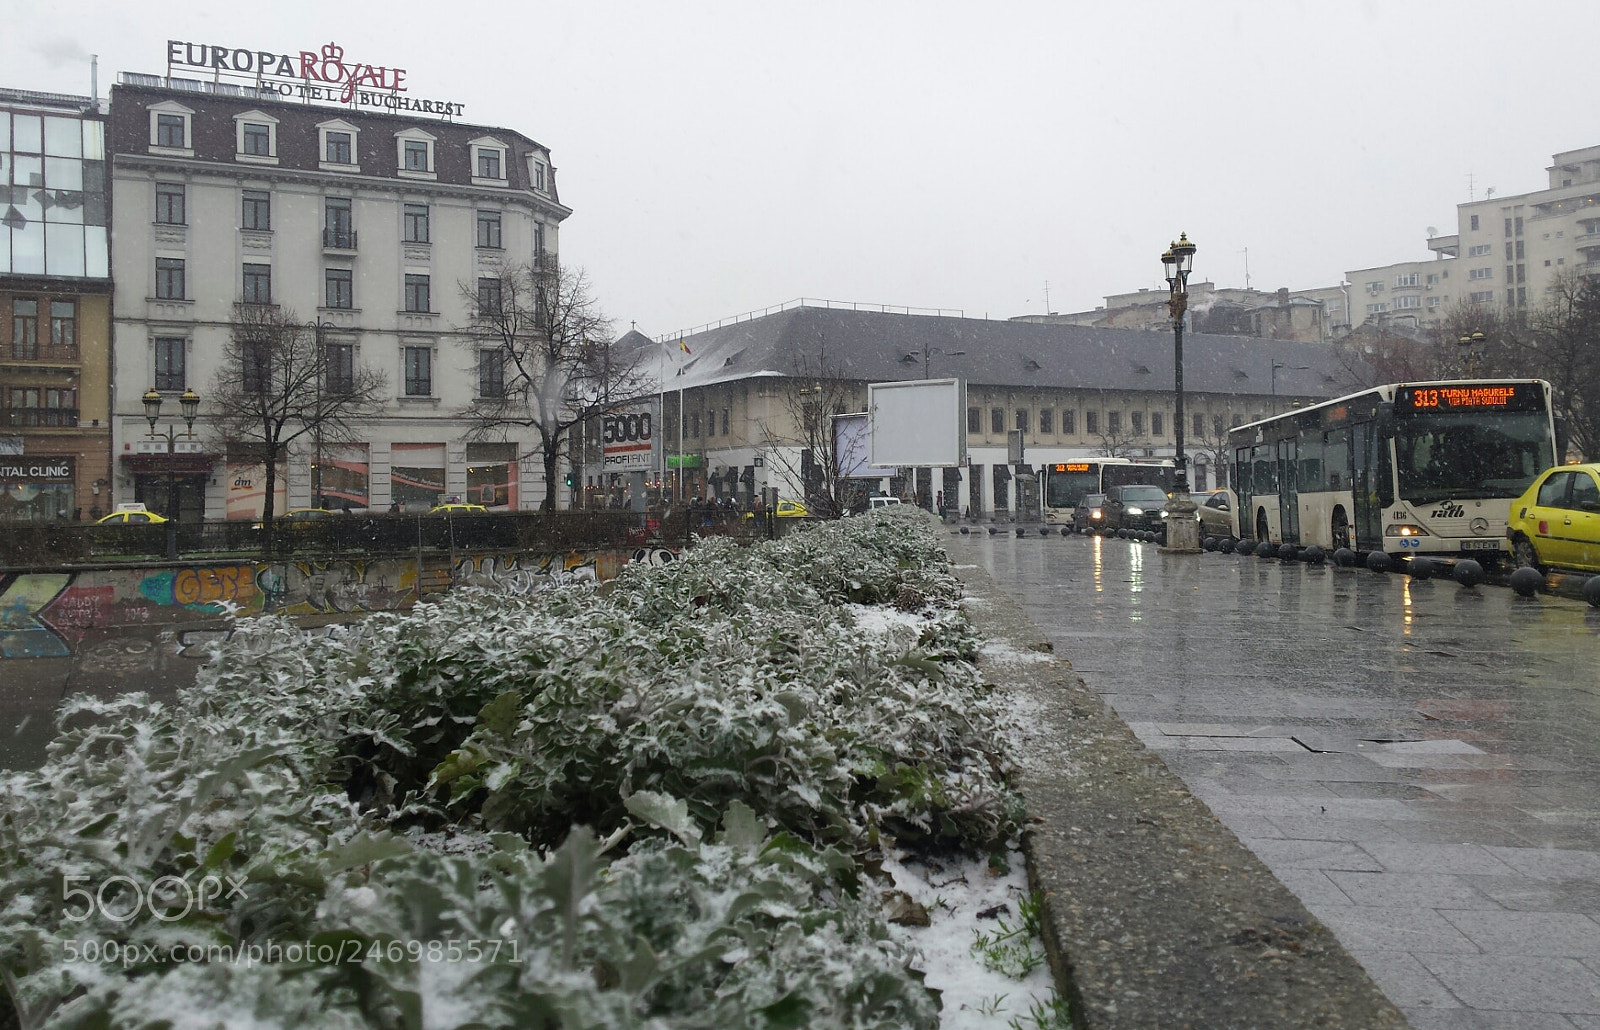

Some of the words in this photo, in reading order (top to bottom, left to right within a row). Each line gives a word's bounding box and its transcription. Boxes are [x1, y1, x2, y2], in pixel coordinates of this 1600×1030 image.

[167, 40, 295, 78] EUROPA
[260, 80, 337, 102] HOTEL
[361, 93, 465, 117] BUCHAREST
[1414, 389, 1438, 407] 313
[1440, 388, 1470, 398] TURNU
[1471, 387, 1515, 397] MAGURELE
[603, 413, 652, 443] 5000
[29, 466, 70, 477] CLINIC
[234, 477, 251, 487] dm
